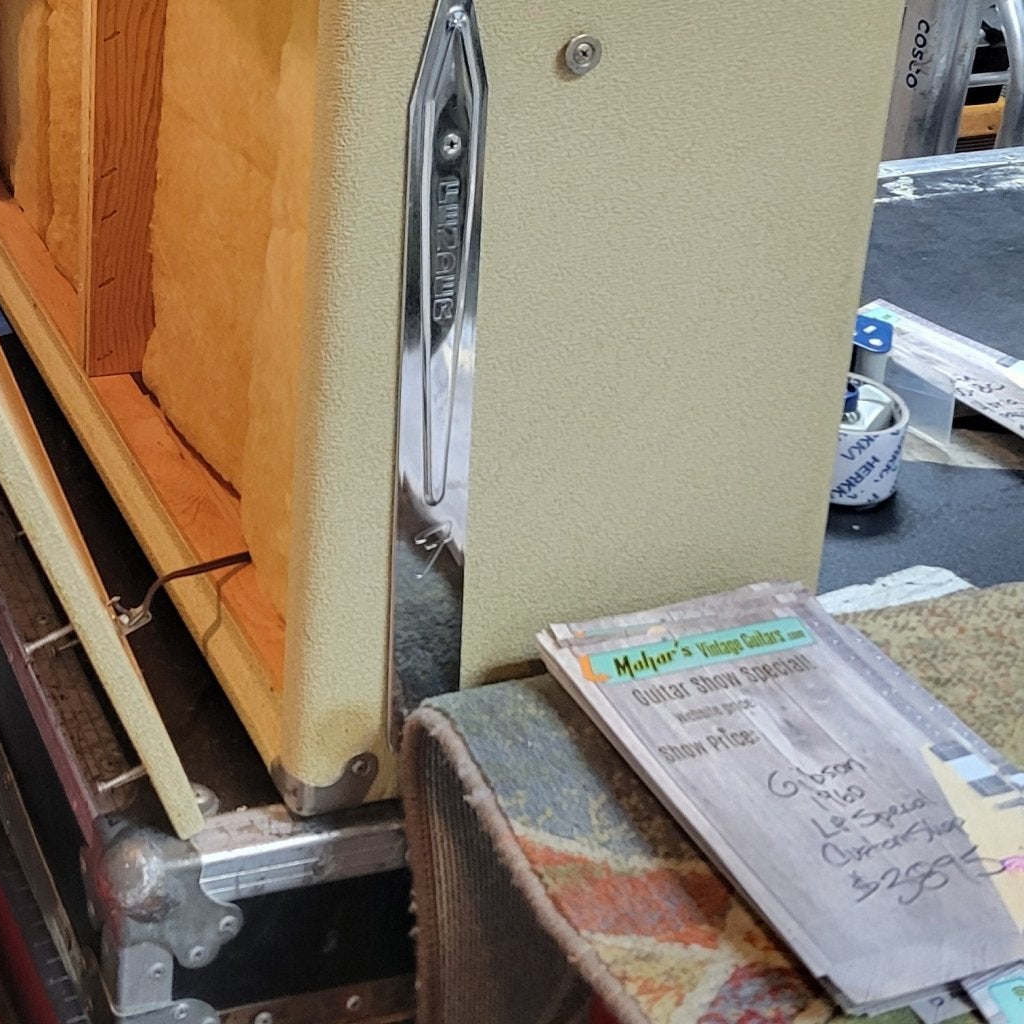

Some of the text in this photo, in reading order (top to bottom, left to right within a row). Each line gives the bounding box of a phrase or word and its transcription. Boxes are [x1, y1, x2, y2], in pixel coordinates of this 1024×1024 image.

[906, 19, 930, 88] COSCO
[432, 180, 460, 322] FENDER
[829, 456, 880, 499] HERKK
[614, 639, 693, 678] Mahar's
[695, 638, 743, 658] Vintage
[740, 629, 786, 649] Guitars
[632, 679, 690, 707] Guitar
[690, 669, 742, 694] Show
[658, 727, 761, 764] Show Price:
[767, 758, 867, 798] Gibson
[811, 784, 866, 811] 1960
